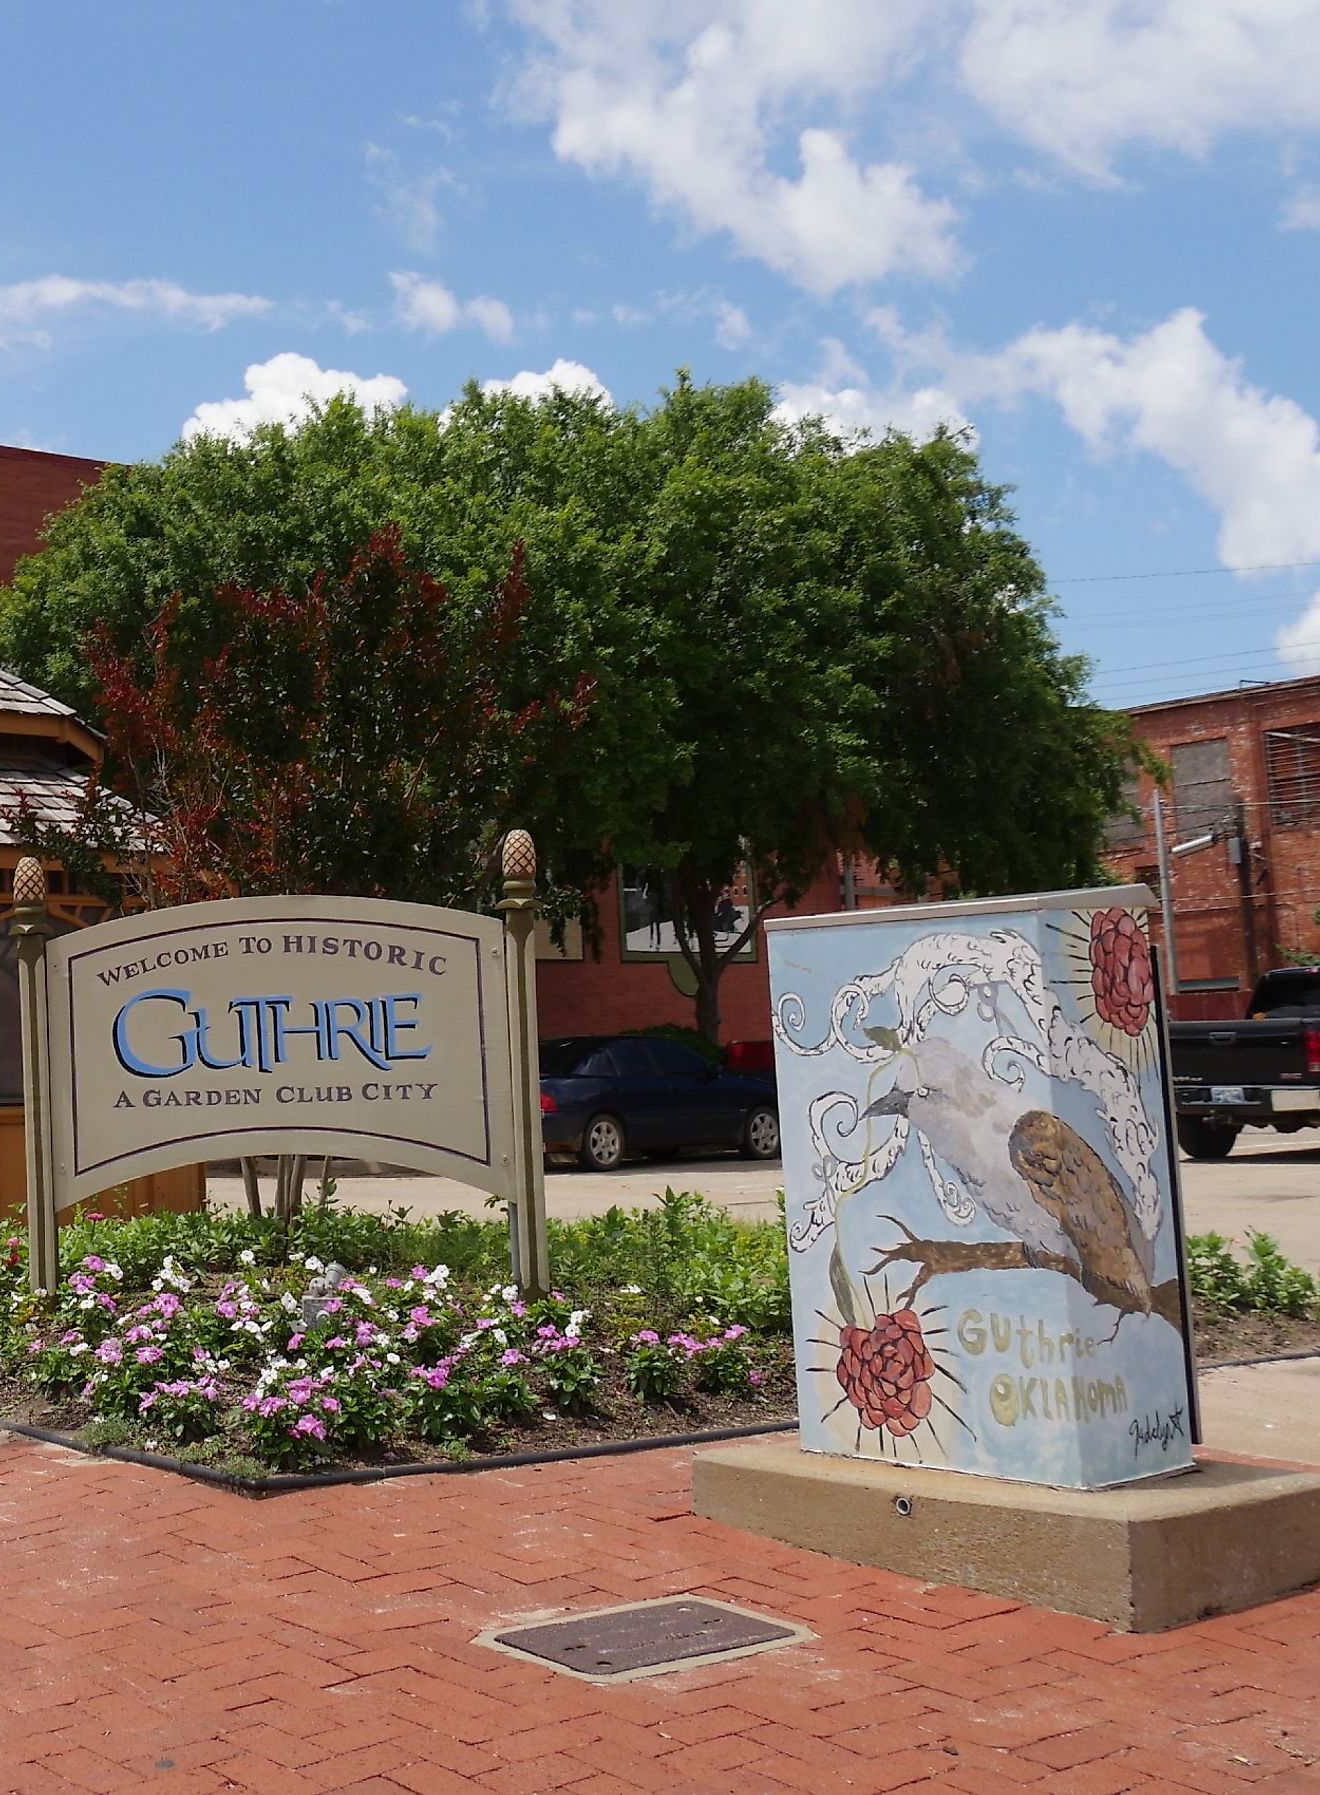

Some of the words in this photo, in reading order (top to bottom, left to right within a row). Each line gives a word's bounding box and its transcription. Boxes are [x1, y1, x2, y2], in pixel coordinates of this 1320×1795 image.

[97, 941, 229, 987] WELCOME
[239, 936, 273, 955] TO
[282, 934, 448, 977] HISTORIC
[112, 987, 435, 1079] GUTHRIE
[114, 1090, 136, 1108] A
[141, 1087, 262, 1108] GARDEN
[275, 1083, 354, 1104] CLUB
[361, 1081, 439, 1102] CITY
